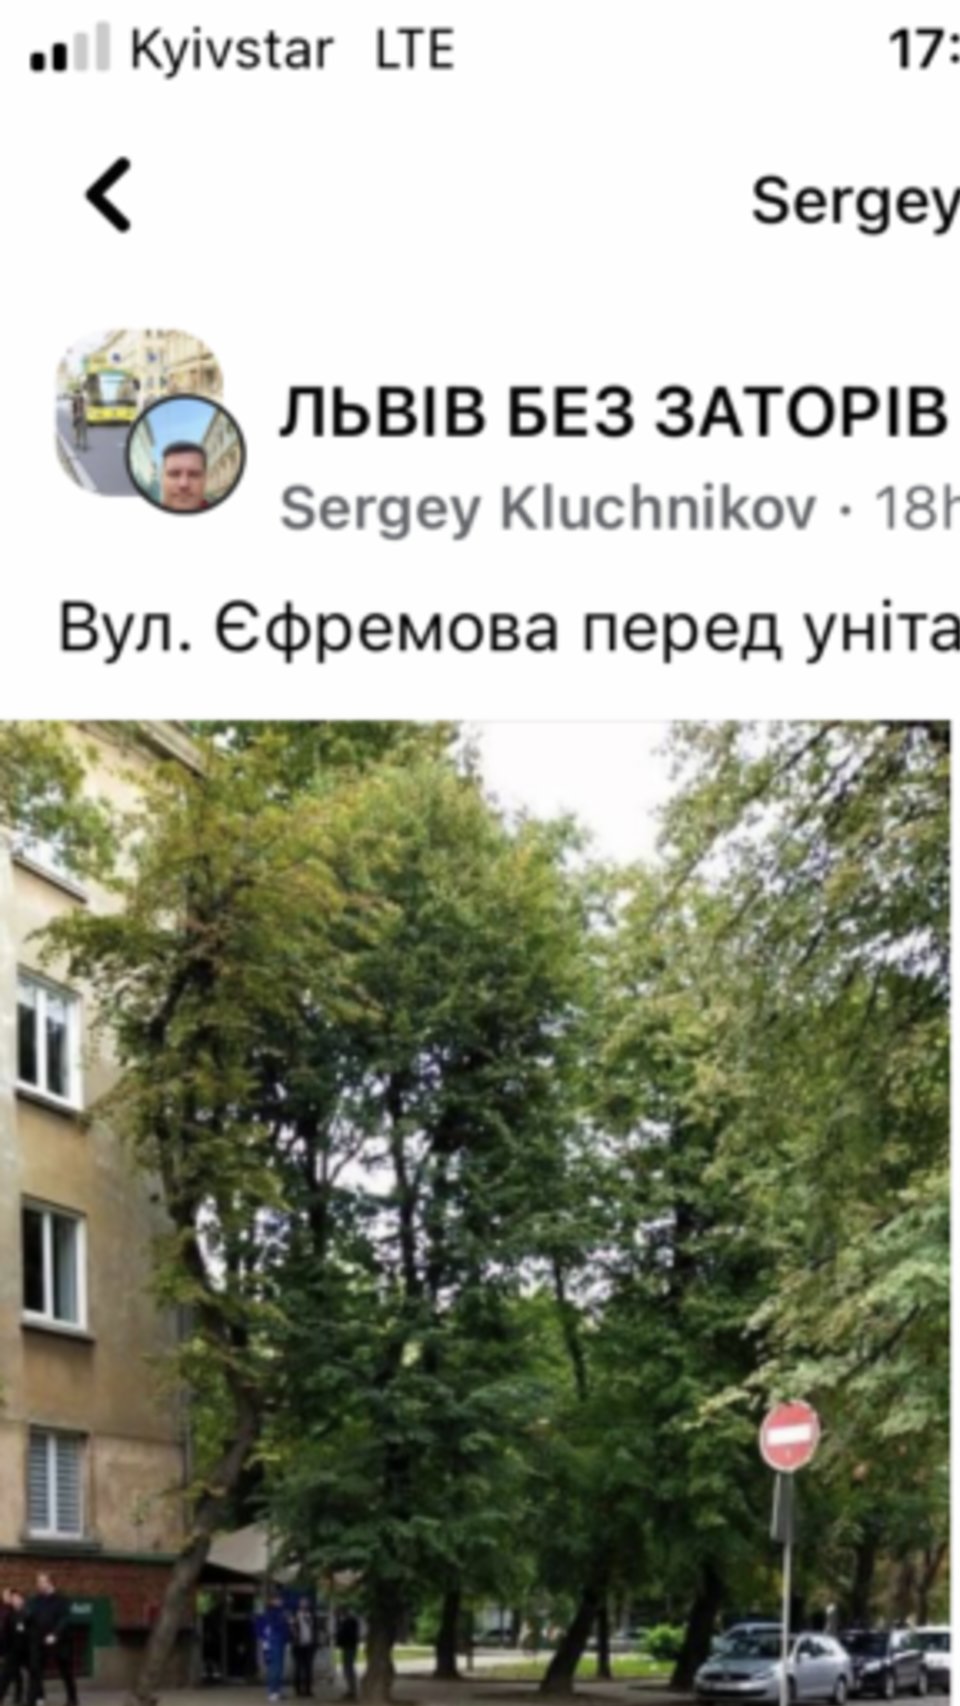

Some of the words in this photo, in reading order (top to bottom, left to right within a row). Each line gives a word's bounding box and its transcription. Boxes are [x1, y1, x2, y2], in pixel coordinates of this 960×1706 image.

[132, 26, 334, 80] Kyivstar
[377, 27, 454, 70] LTE
[279, 385, 486, 438] ЛЬВІВ
[509, 384, 634, 438] БЕЗ
[655, 384, 948, 438] ЗАТОРІВ
[282, 485, 481, 540] Sergey
[502, 482, 816, 530] Kluchnikov
[60, 600, 191, 665] Вул.
[215, 599, 558, 665] Єфремова
[584, 612, 783, 665] перед
